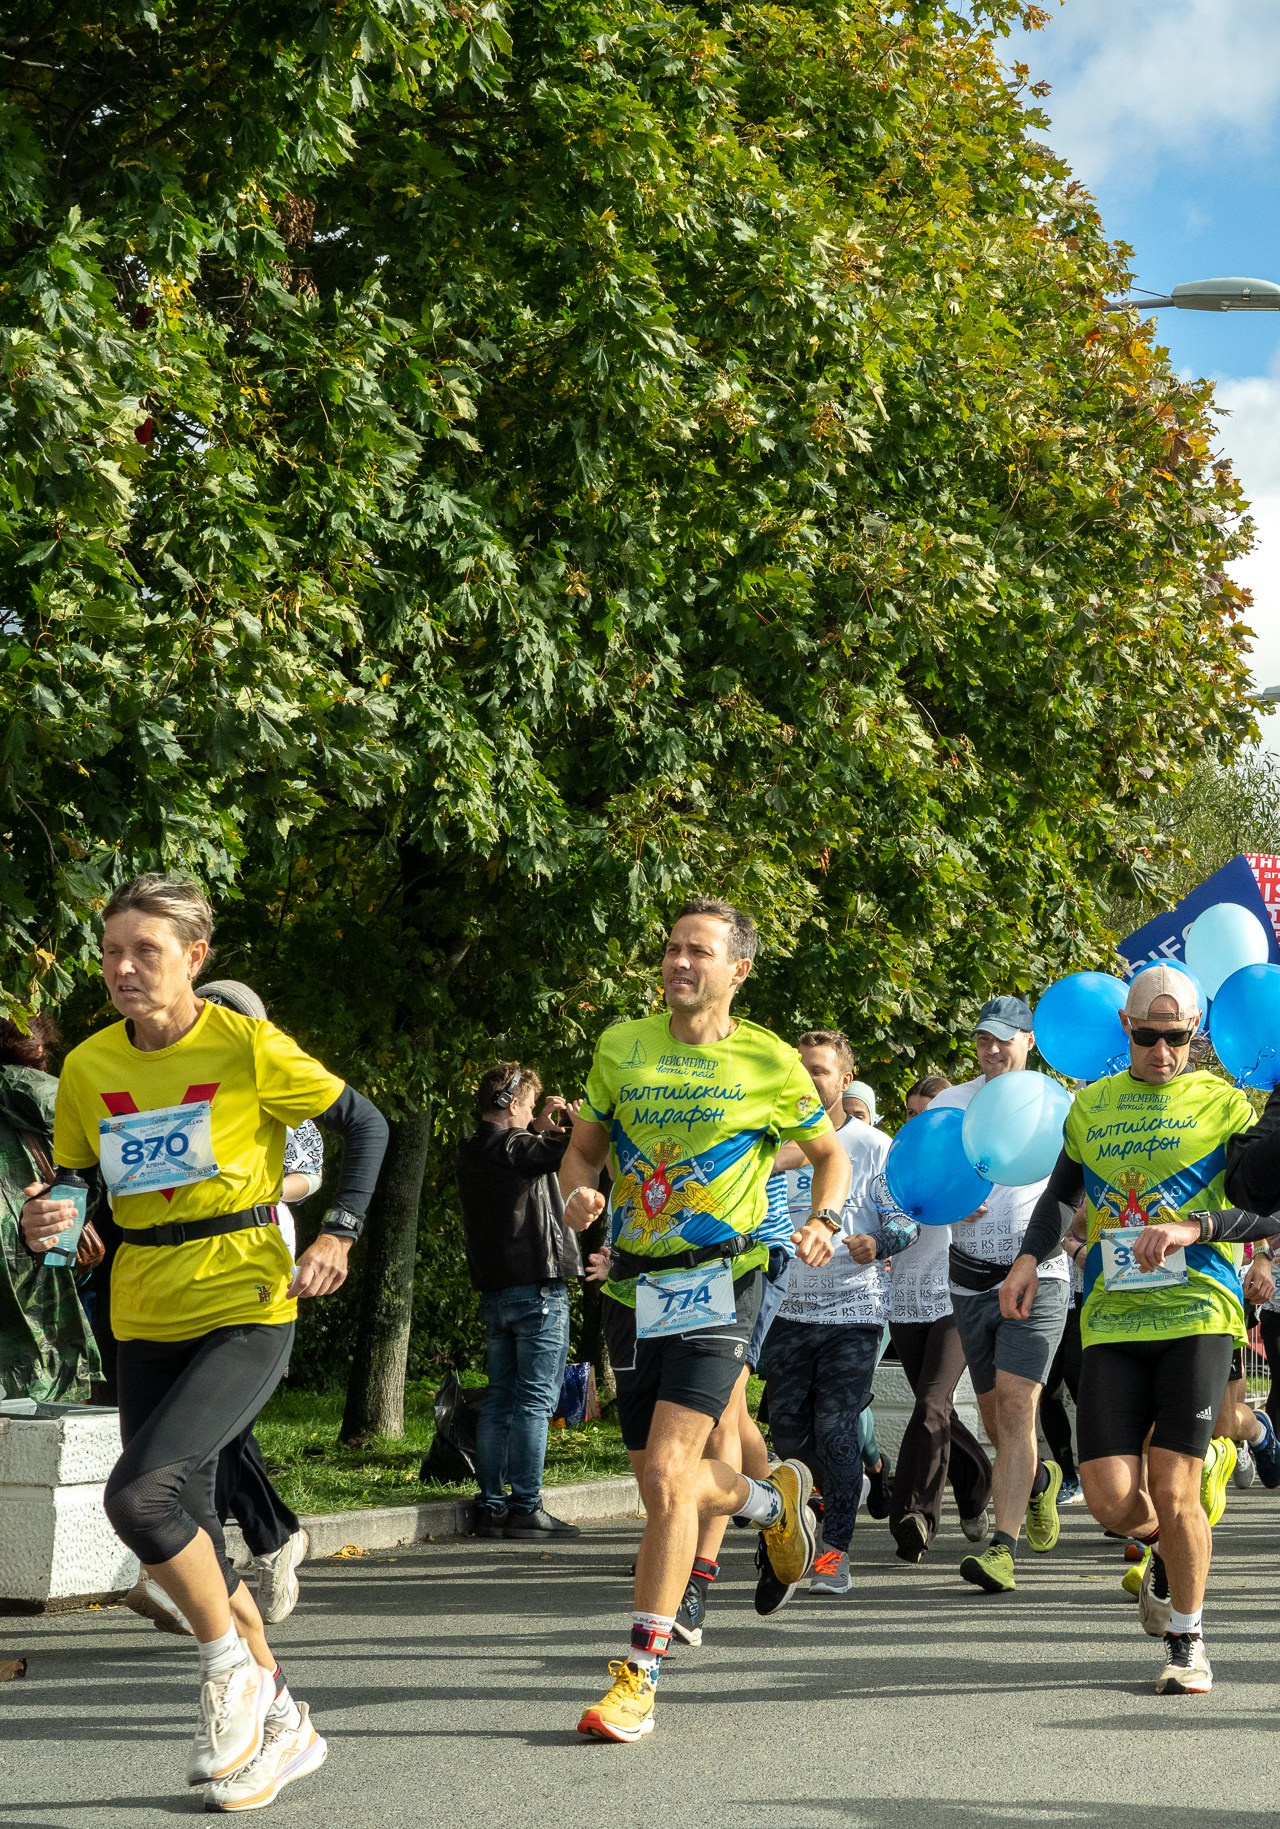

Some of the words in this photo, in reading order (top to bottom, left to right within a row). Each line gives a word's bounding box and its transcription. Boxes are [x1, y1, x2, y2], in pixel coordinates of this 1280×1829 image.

[658, 1055, 719, 1071] ПЕЙСМЕЙКЕР
[619, 1081, 747, 1104] Балтийский
[1086, 1115, 1198, 1143] Балтийский
[121, 1132, 189, 1165] 870
[982, 1239, 995, 1249] RS
[658, 1285, 712, 1313] 774
